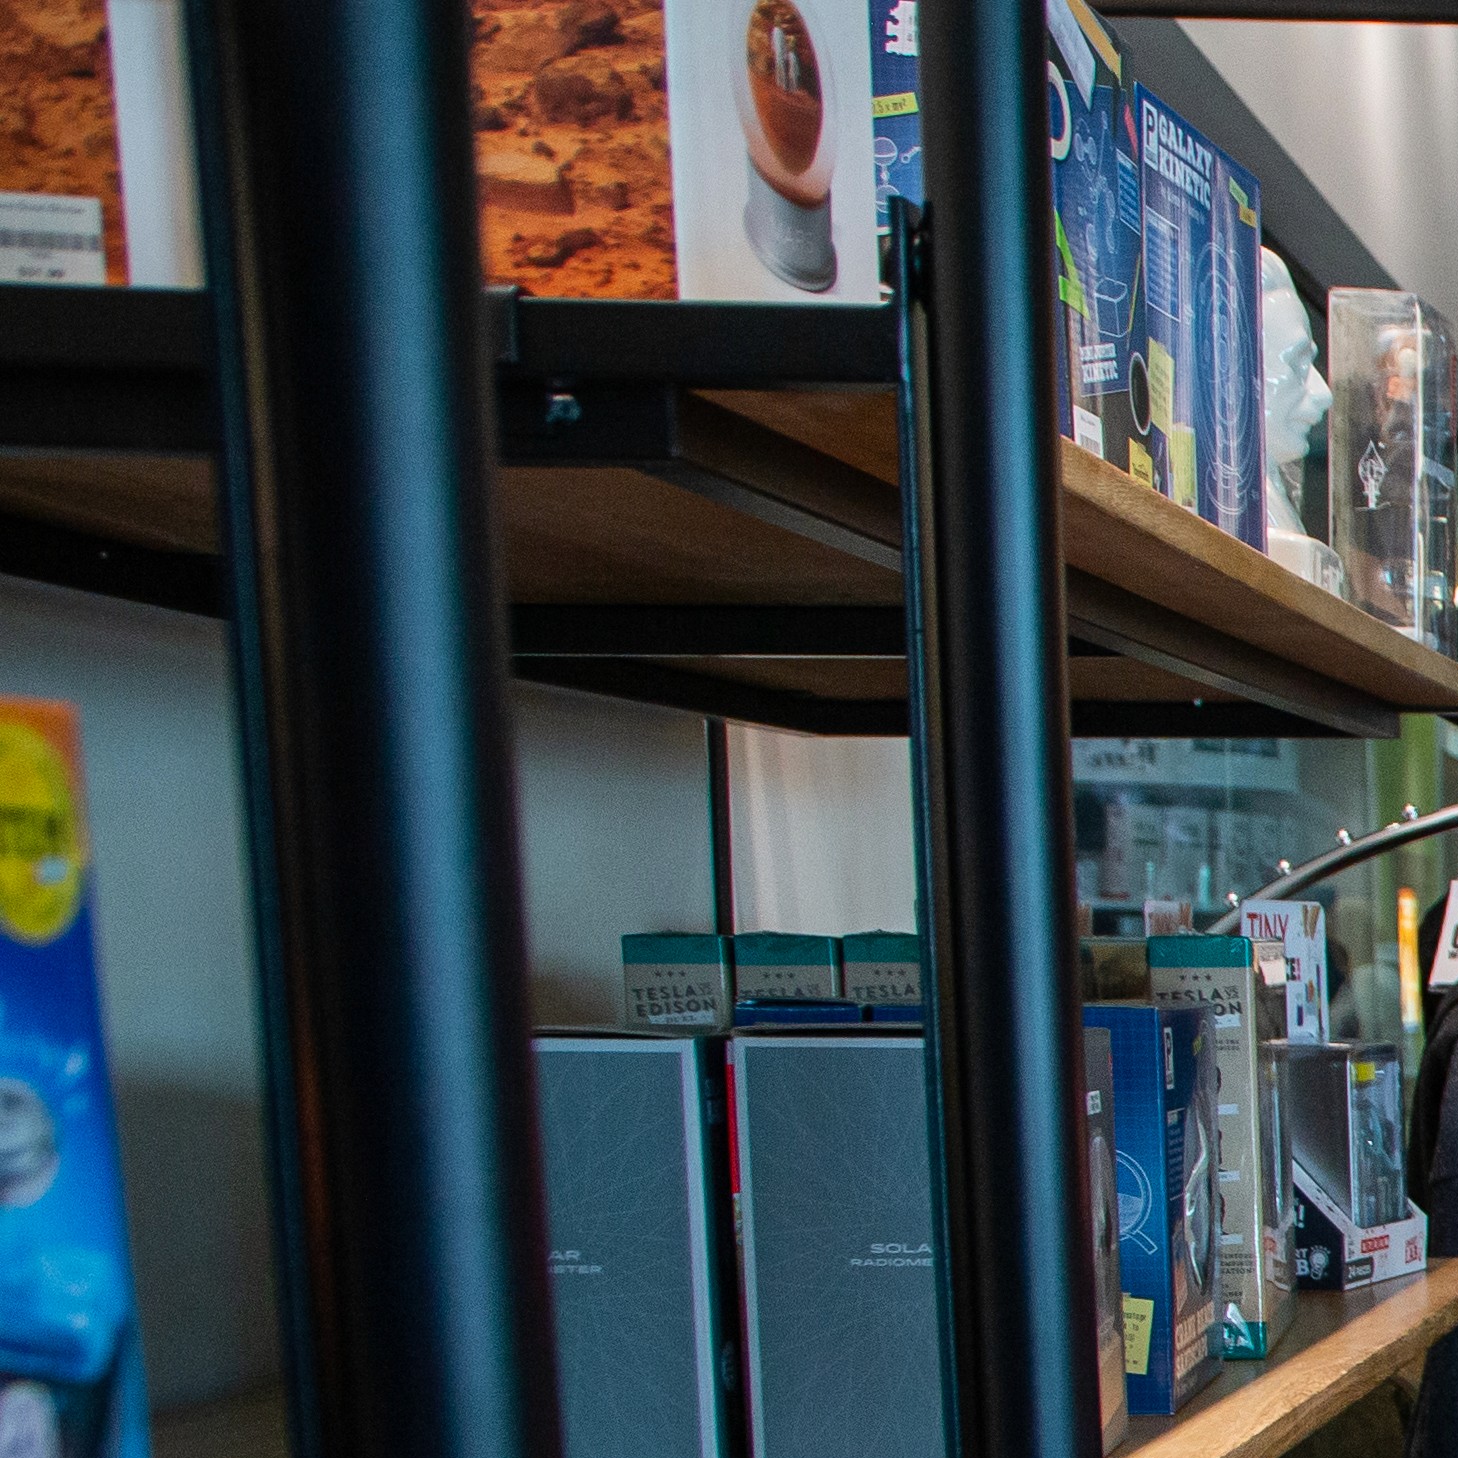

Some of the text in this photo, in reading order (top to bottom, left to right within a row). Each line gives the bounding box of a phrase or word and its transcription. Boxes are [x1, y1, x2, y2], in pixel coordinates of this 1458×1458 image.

[1159, 114, 1213, 181] GALAXY
[1247, 912, 1290, 940] TINY
[632, 984, 700, 1001] TESLA
[1156, 988, 1224, 1001] TESLA
[635, 999, 718, 1017] EDISON
[869, 1243, 933, 1254] SOLA
[850, 1257, 934, 1267] RADIOME
